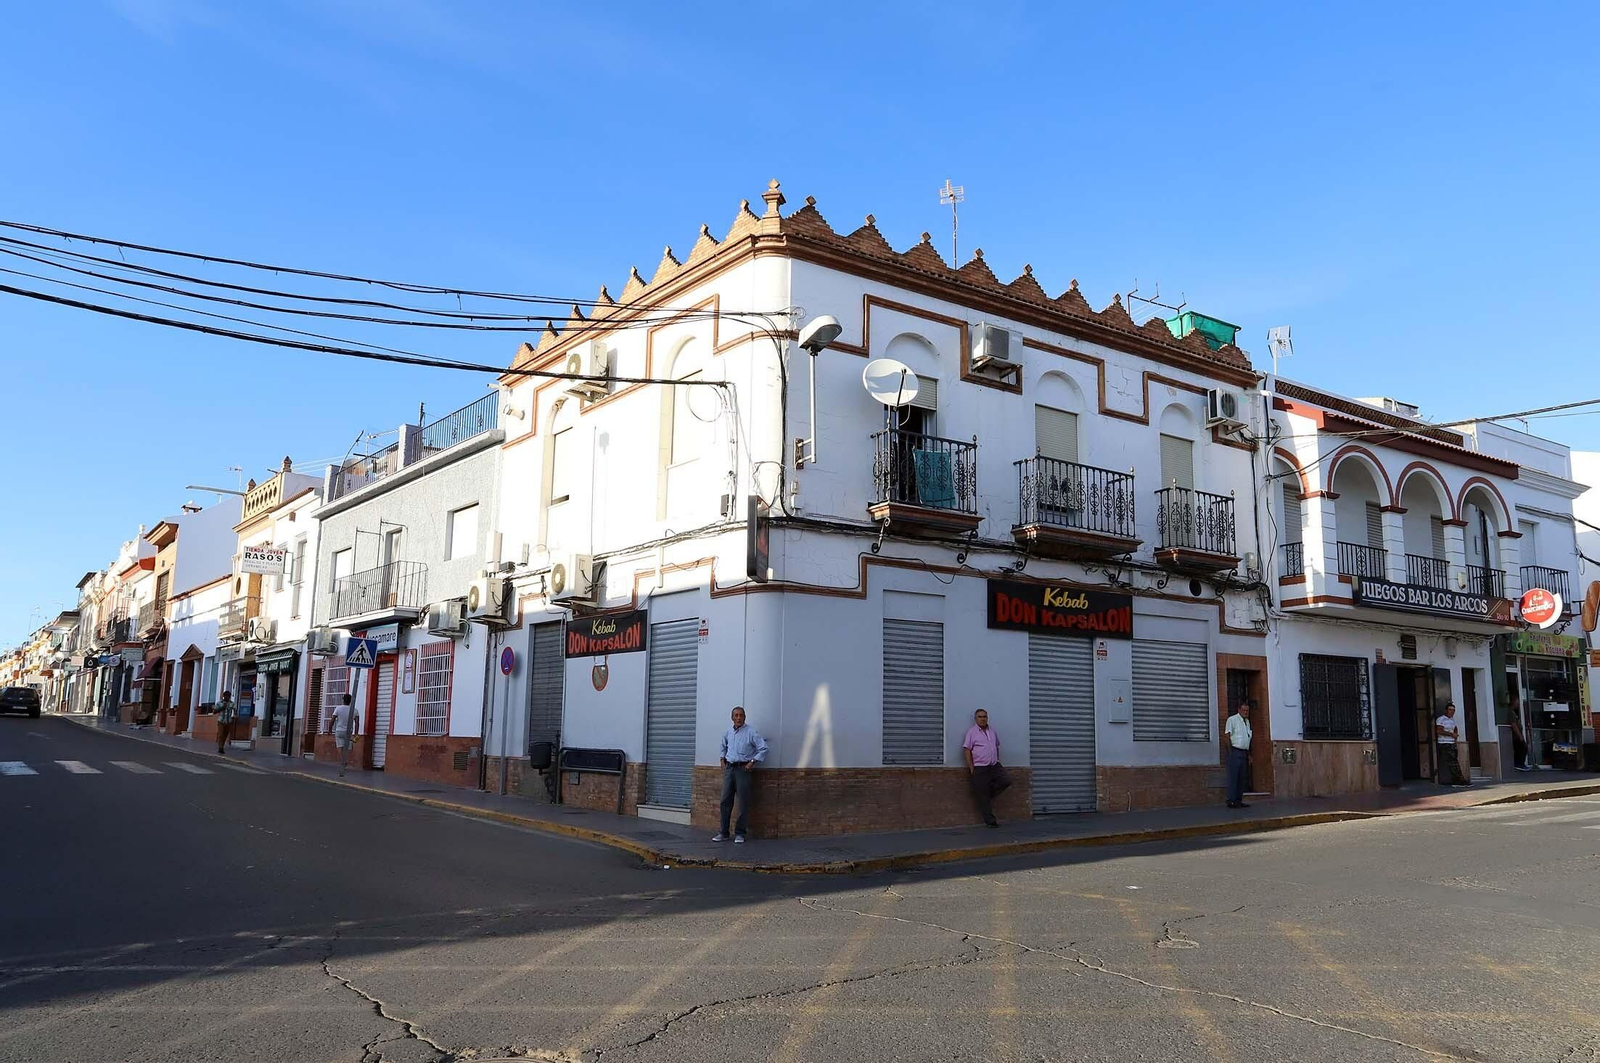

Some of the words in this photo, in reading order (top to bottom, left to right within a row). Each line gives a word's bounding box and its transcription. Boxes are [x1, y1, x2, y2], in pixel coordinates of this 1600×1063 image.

[245, 552, 282, 562] RASO'S
[1043, 588, 1089, 610] Kebab
[1362, 581, 1406, 602] JUEGOS
[1408, 588, 1429, 605] BAR
[1432, 592, 1452, 609] LOS
[1454, 596, 1488, 613] ARCOS
[592, 618, 616, 635] Kebab
[996, 592, 1036, 625] DON
[1041, 606, 1130, 634] KAPSALON
[569, 631, 586, 654] DON
[590, 622, 641, 652] KAPSALON
